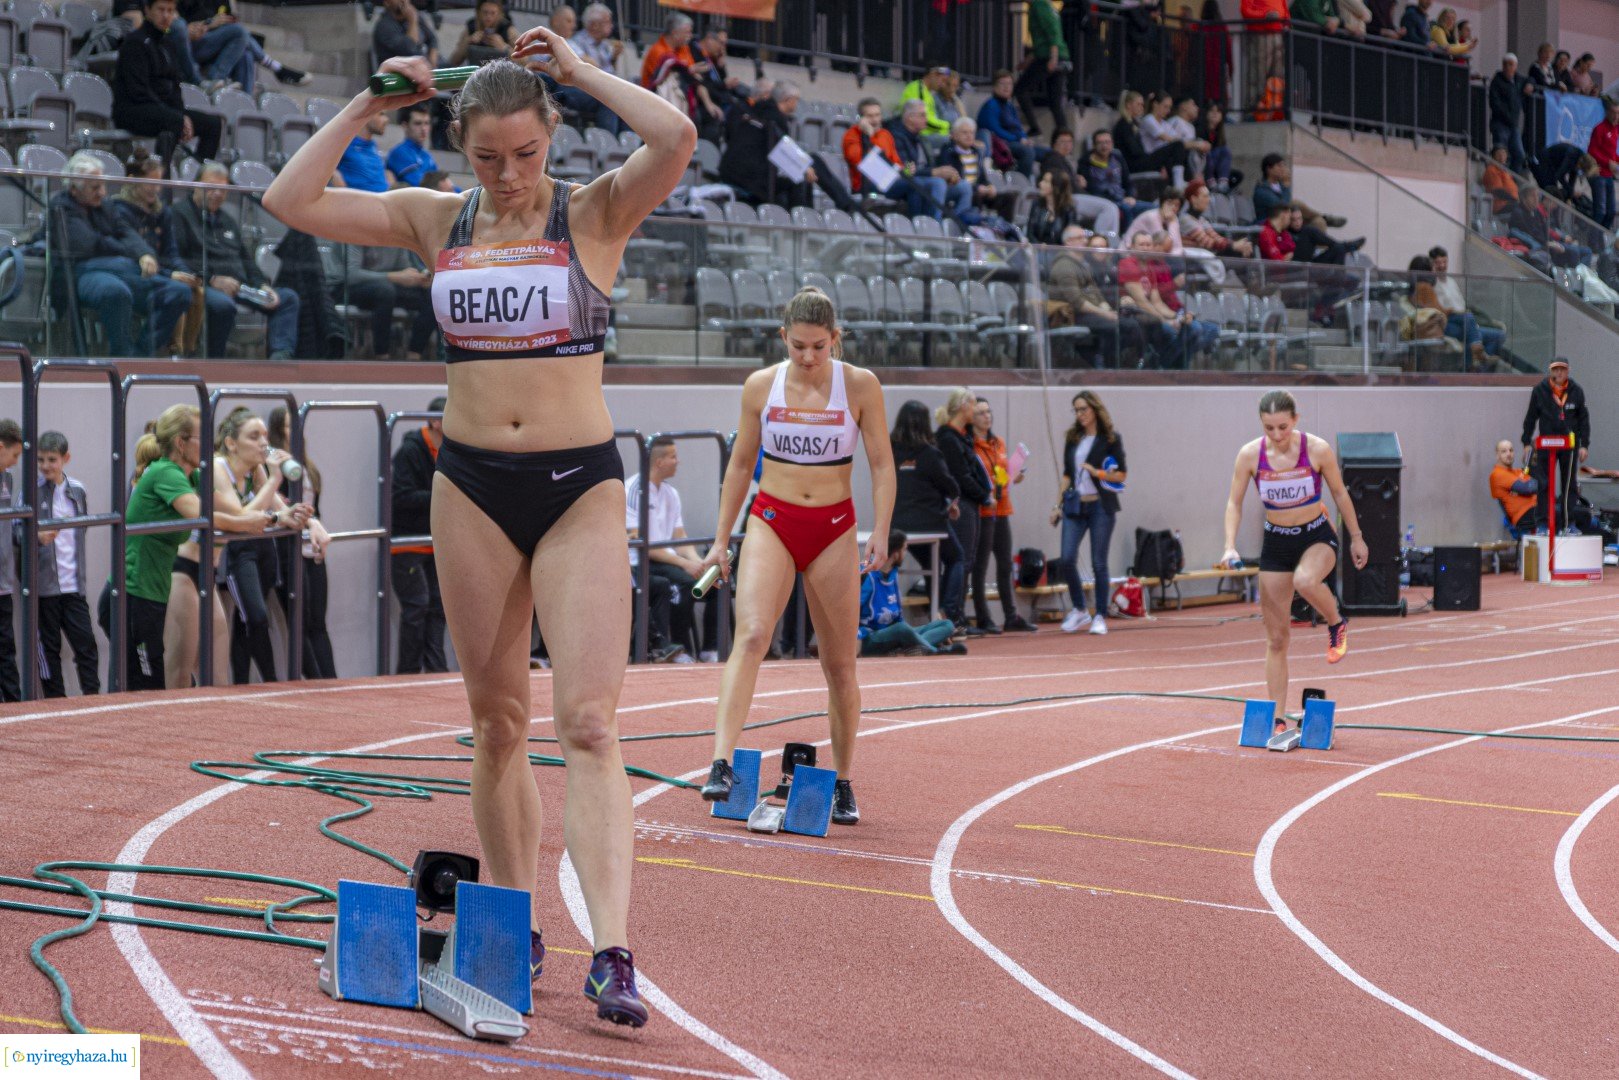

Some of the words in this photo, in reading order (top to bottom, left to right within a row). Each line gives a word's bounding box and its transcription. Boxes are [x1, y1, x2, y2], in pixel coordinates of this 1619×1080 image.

[485, 245, 556, 256] FEDETTPÁLYÁS
[449, 285, 549, 324] BEAC/1
[456, 337, 530, 351] NYÍREGYHÁZA
[532, 334, 558, 347] 2023
[555, 345, 578, 354] NIKE
[578, 342, 595, 353] PRO
[773, 433, 839, 456] VASAS/1
[1267, 485, 1308, 500] GYAC/1
[1272, 525, 1302, 535] PRO
